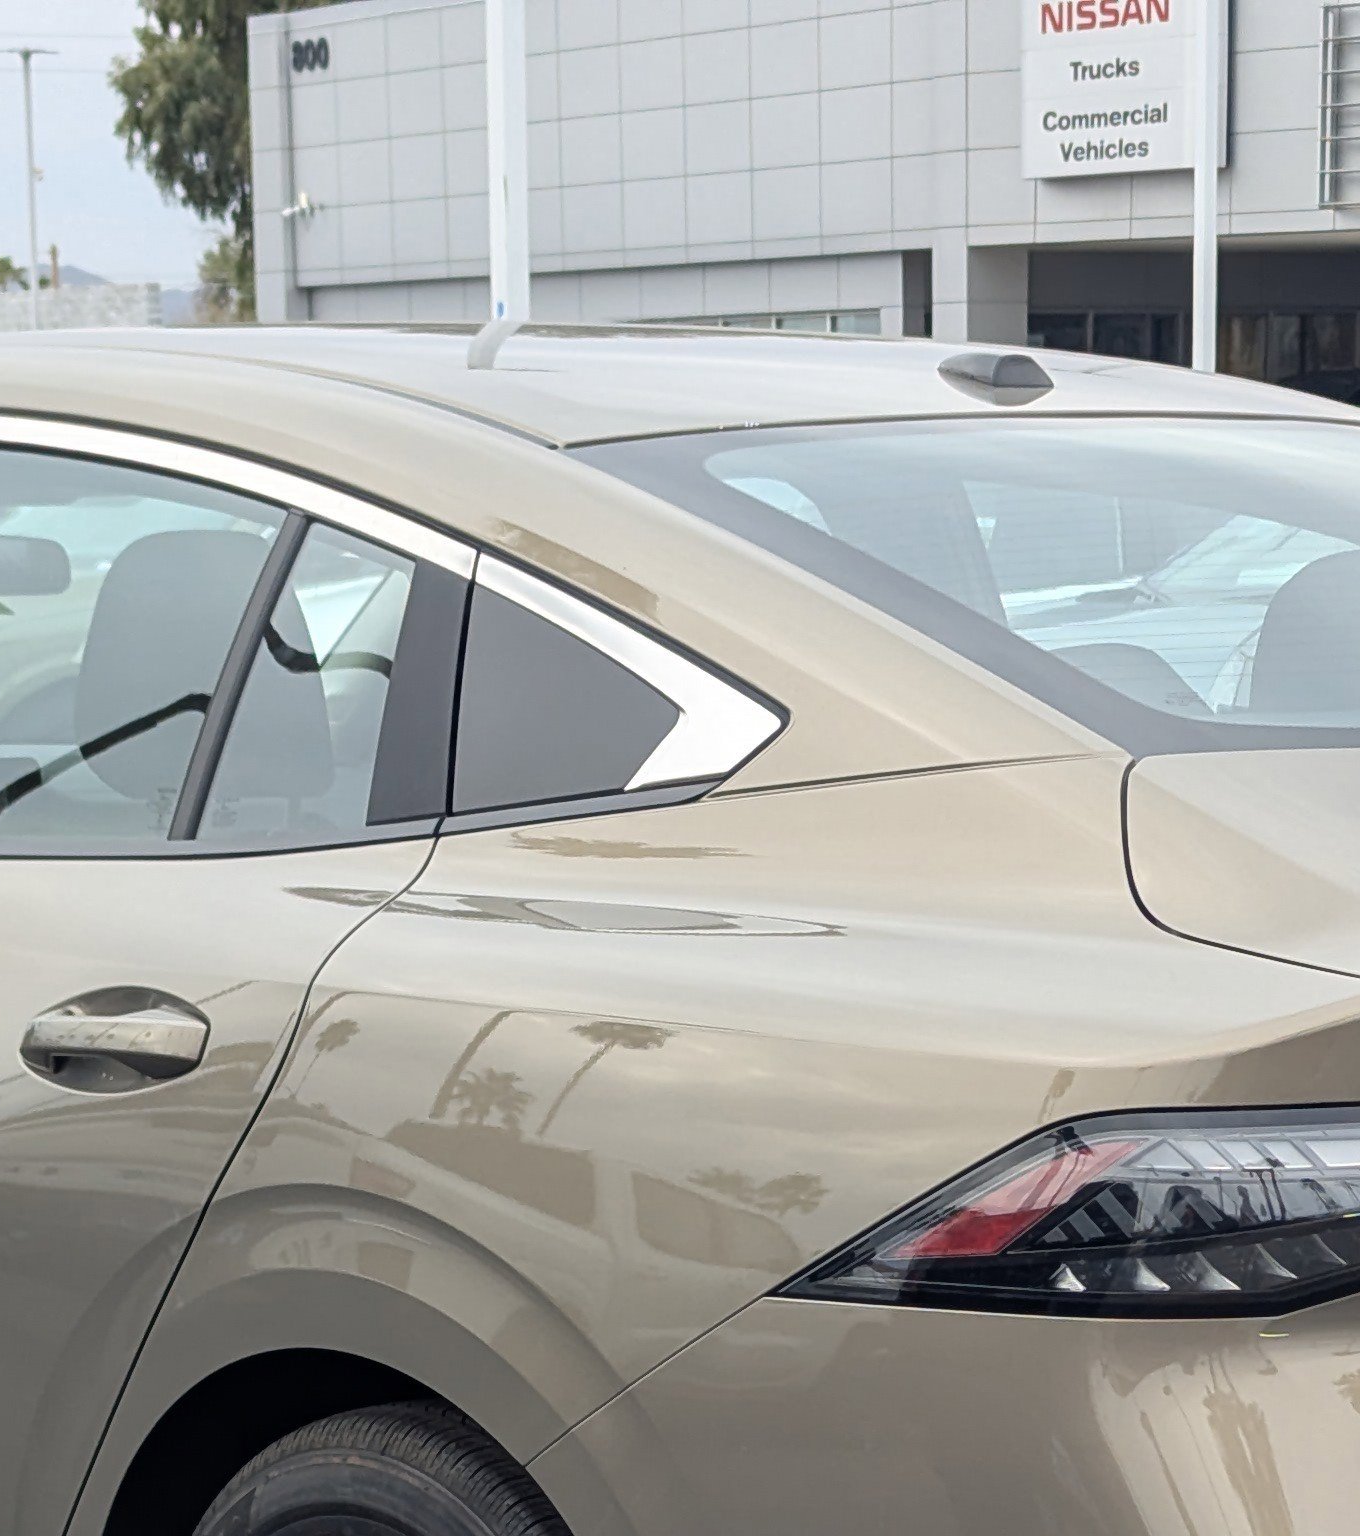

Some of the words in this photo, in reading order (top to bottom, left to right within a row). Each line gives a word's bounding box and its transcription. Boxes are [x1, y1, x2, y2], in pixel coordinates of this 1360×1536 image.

[1041, 0, 1170, 34] NISSAN
[1070, 58, 1140, 81] Trucks
[1042, 102, 1168, 132] Commercial
[1060, 138, 1149, 162] Vehicles
